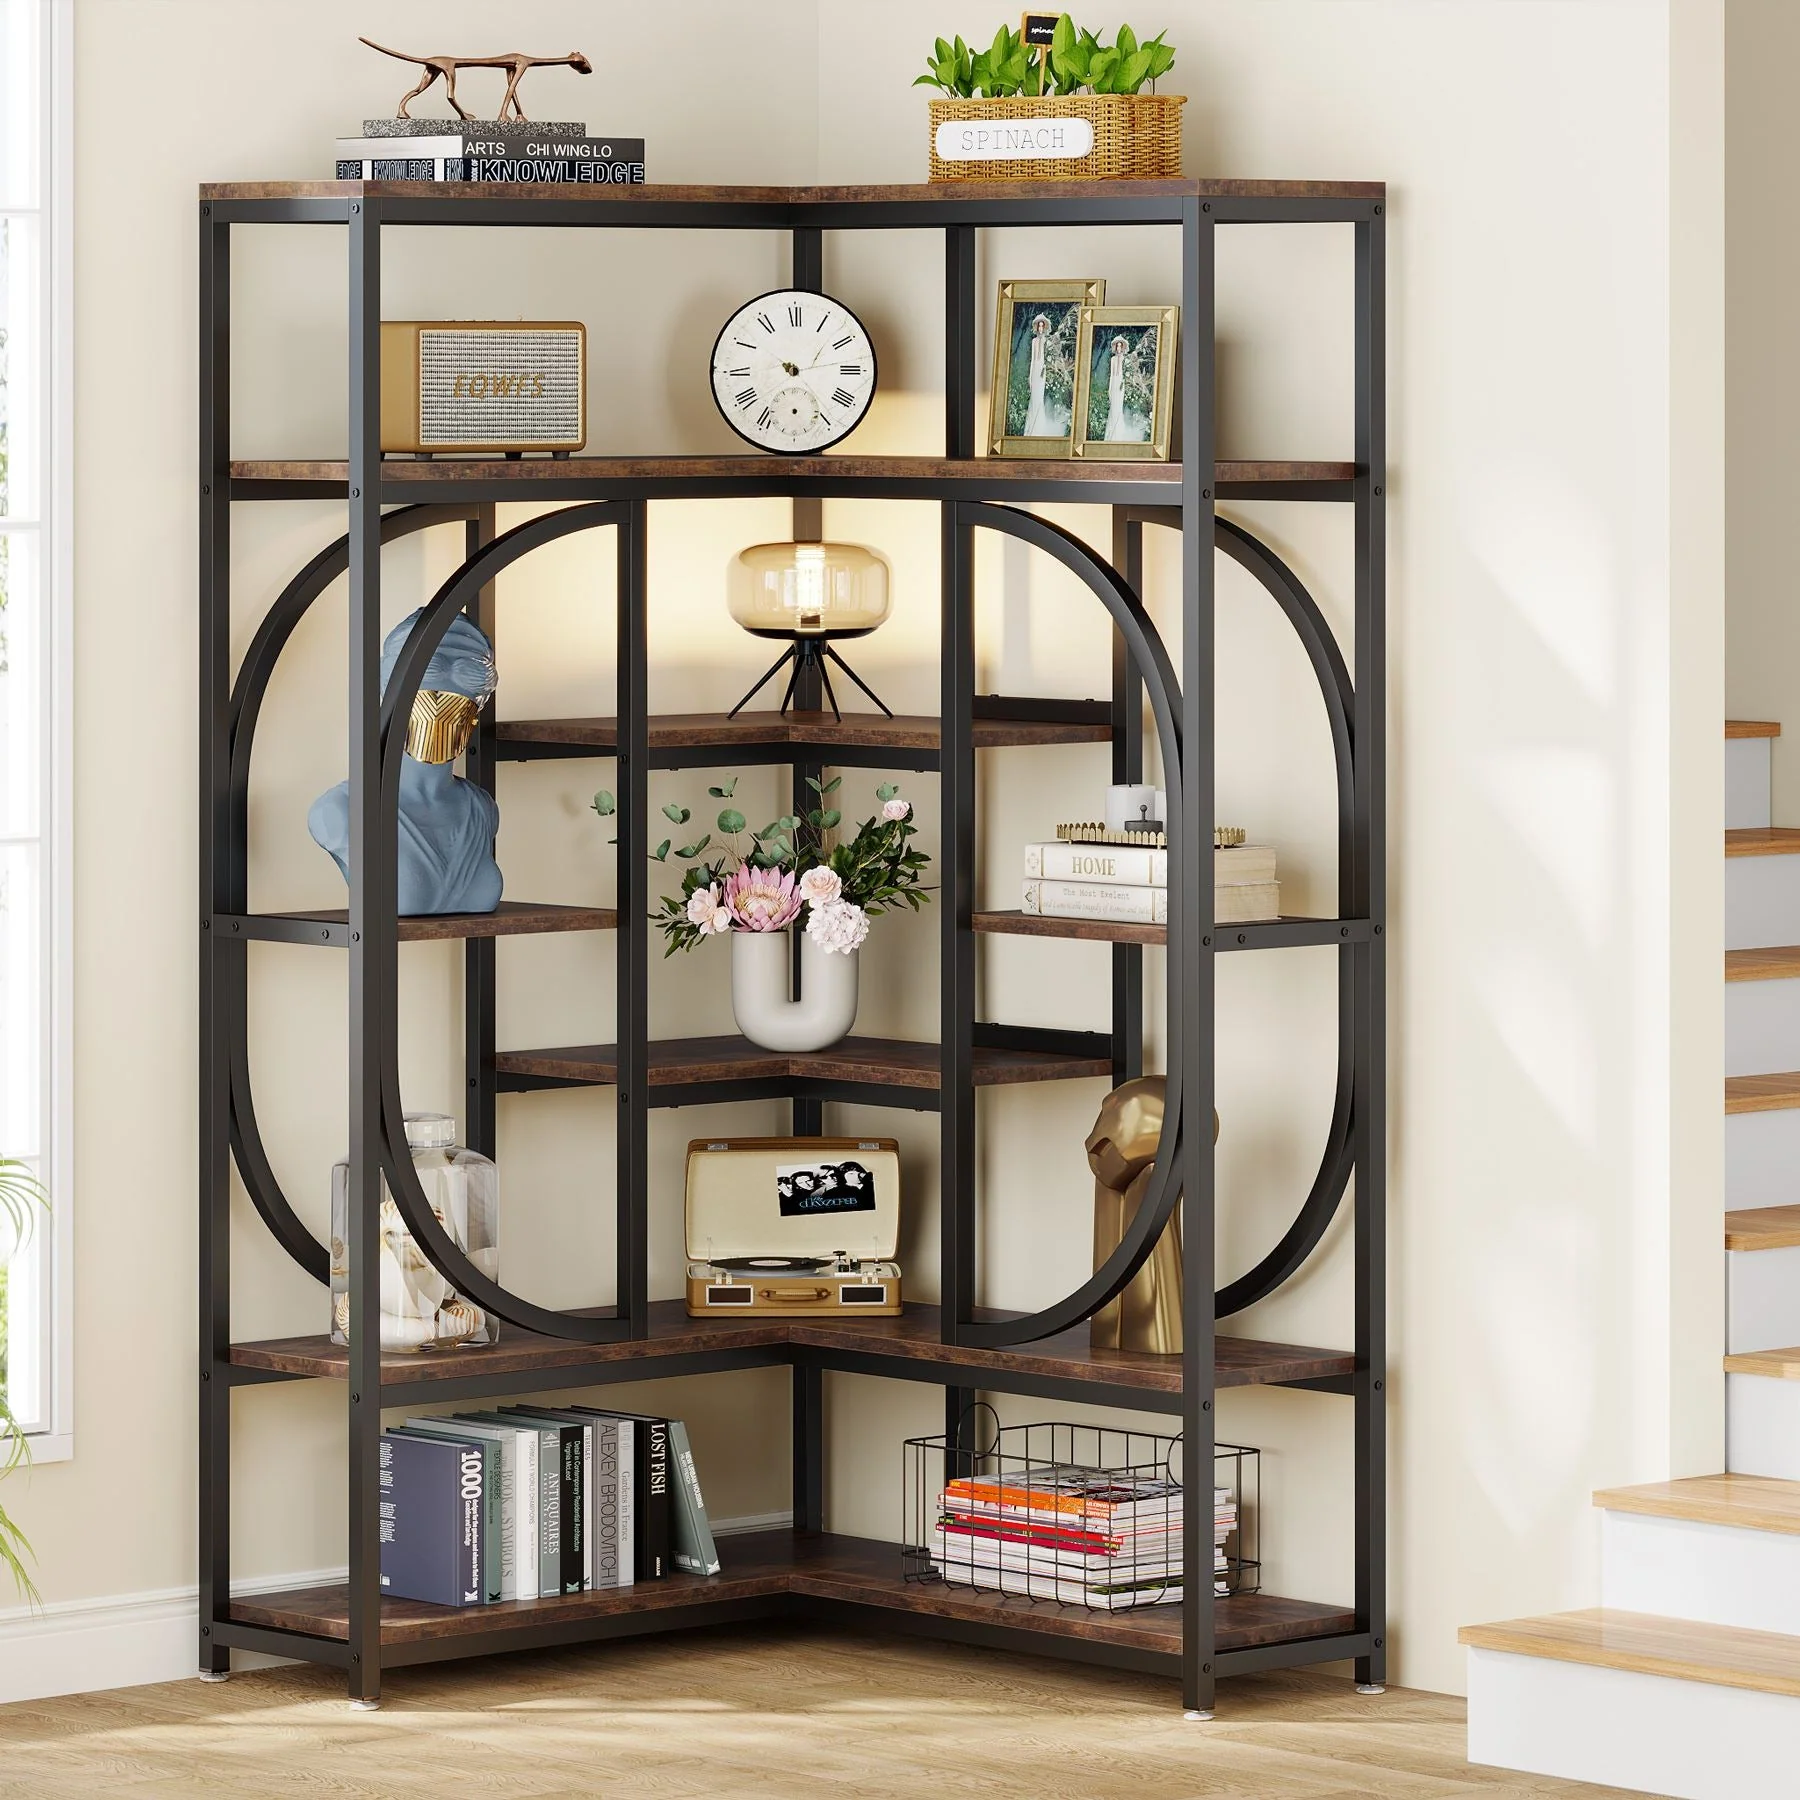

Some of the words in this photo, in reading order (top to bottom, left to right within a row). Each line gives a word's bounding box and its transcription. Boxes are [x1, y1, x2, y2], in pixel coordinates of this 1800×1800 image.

[465, 142, 505, 155] ARTS
[526, 143, 549, 156] CHI
[553, 143, 589, 157] WING
[593, 145, 612, 158] LO
[961, 128, 1065, 151] SPINACH
[480, 159, 644, 184] KNOWLEDGE
[1072, 856, 1116, 876] HOME
[1063, 887, 1076, 896] The
[1079, 889, 1097, 897] Most
[528, 1440, 536, 1467] FORMULA
[564, 1441, 572, 1460] Virginia
[573, 1440, 581, 1455] Detail
[601, 1424, 617, 1479] ALEXEY
[651, 1423, 666, 1460] LOST
[493, 1450, 501, 1471] TEXTILE
[461, 1450, 482, 1500] 1000
[493, 1471, 501, 1500] DESIGNERS
[502, 1469, 513, 1504] BOOK
[528, 1471, 536, 1492] WORLD
[572, 1460, 581, 1495] Contemporary
[621, 1471, 631, 1503] Gardens
[651, 1463, 666, 1495] FISH
[528, 1492, 536, 1526] CHAMPIONS
[547, 1472, 559, 1554] ANTIQUAIRES
[573, 1495, 581, 1523] Residential
[622, 1504, 631, 1513] in
[573, 1522, 581, 1552] Architecture
[601, 1483, 617, 1579] BRODOVITCH
[621, 1515, 631, 1542] France
[502, 1516, 513, 1578] SYMBOLS
